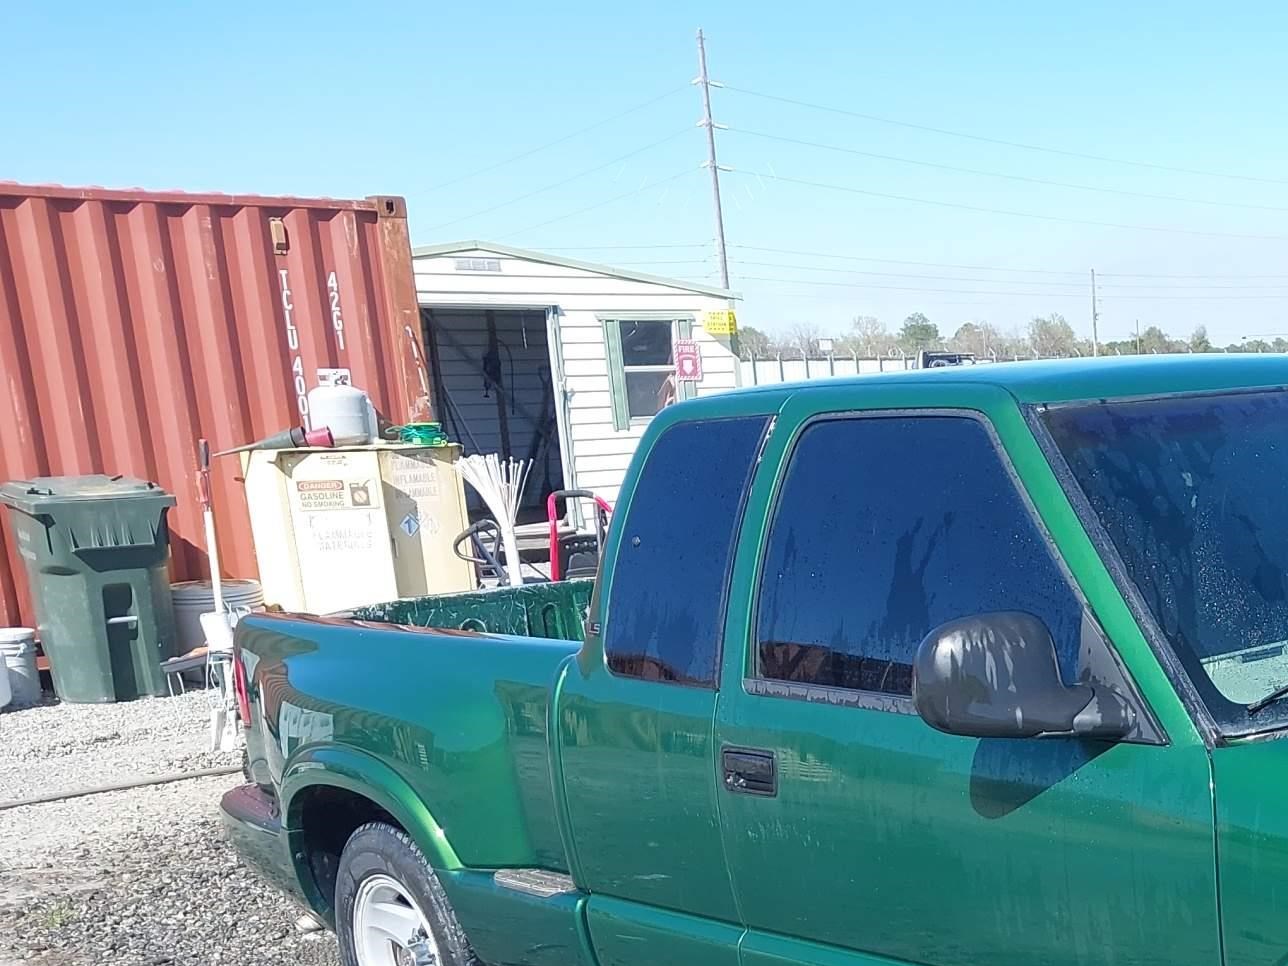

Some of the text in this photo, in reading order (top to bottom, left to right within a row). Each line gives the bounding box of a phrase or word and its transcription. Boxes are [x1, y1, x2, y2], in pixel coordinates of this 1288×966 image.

[279, 269, 299, 350] TCLU
[327, 272, 345, 350] 42G1
[678, 345, 695, 353] FIRE
[303, 482, 337, 490] DANGER
[300, 492, 345, 501] GASOLINE
[314, 500, 345, 508] SMOKING
